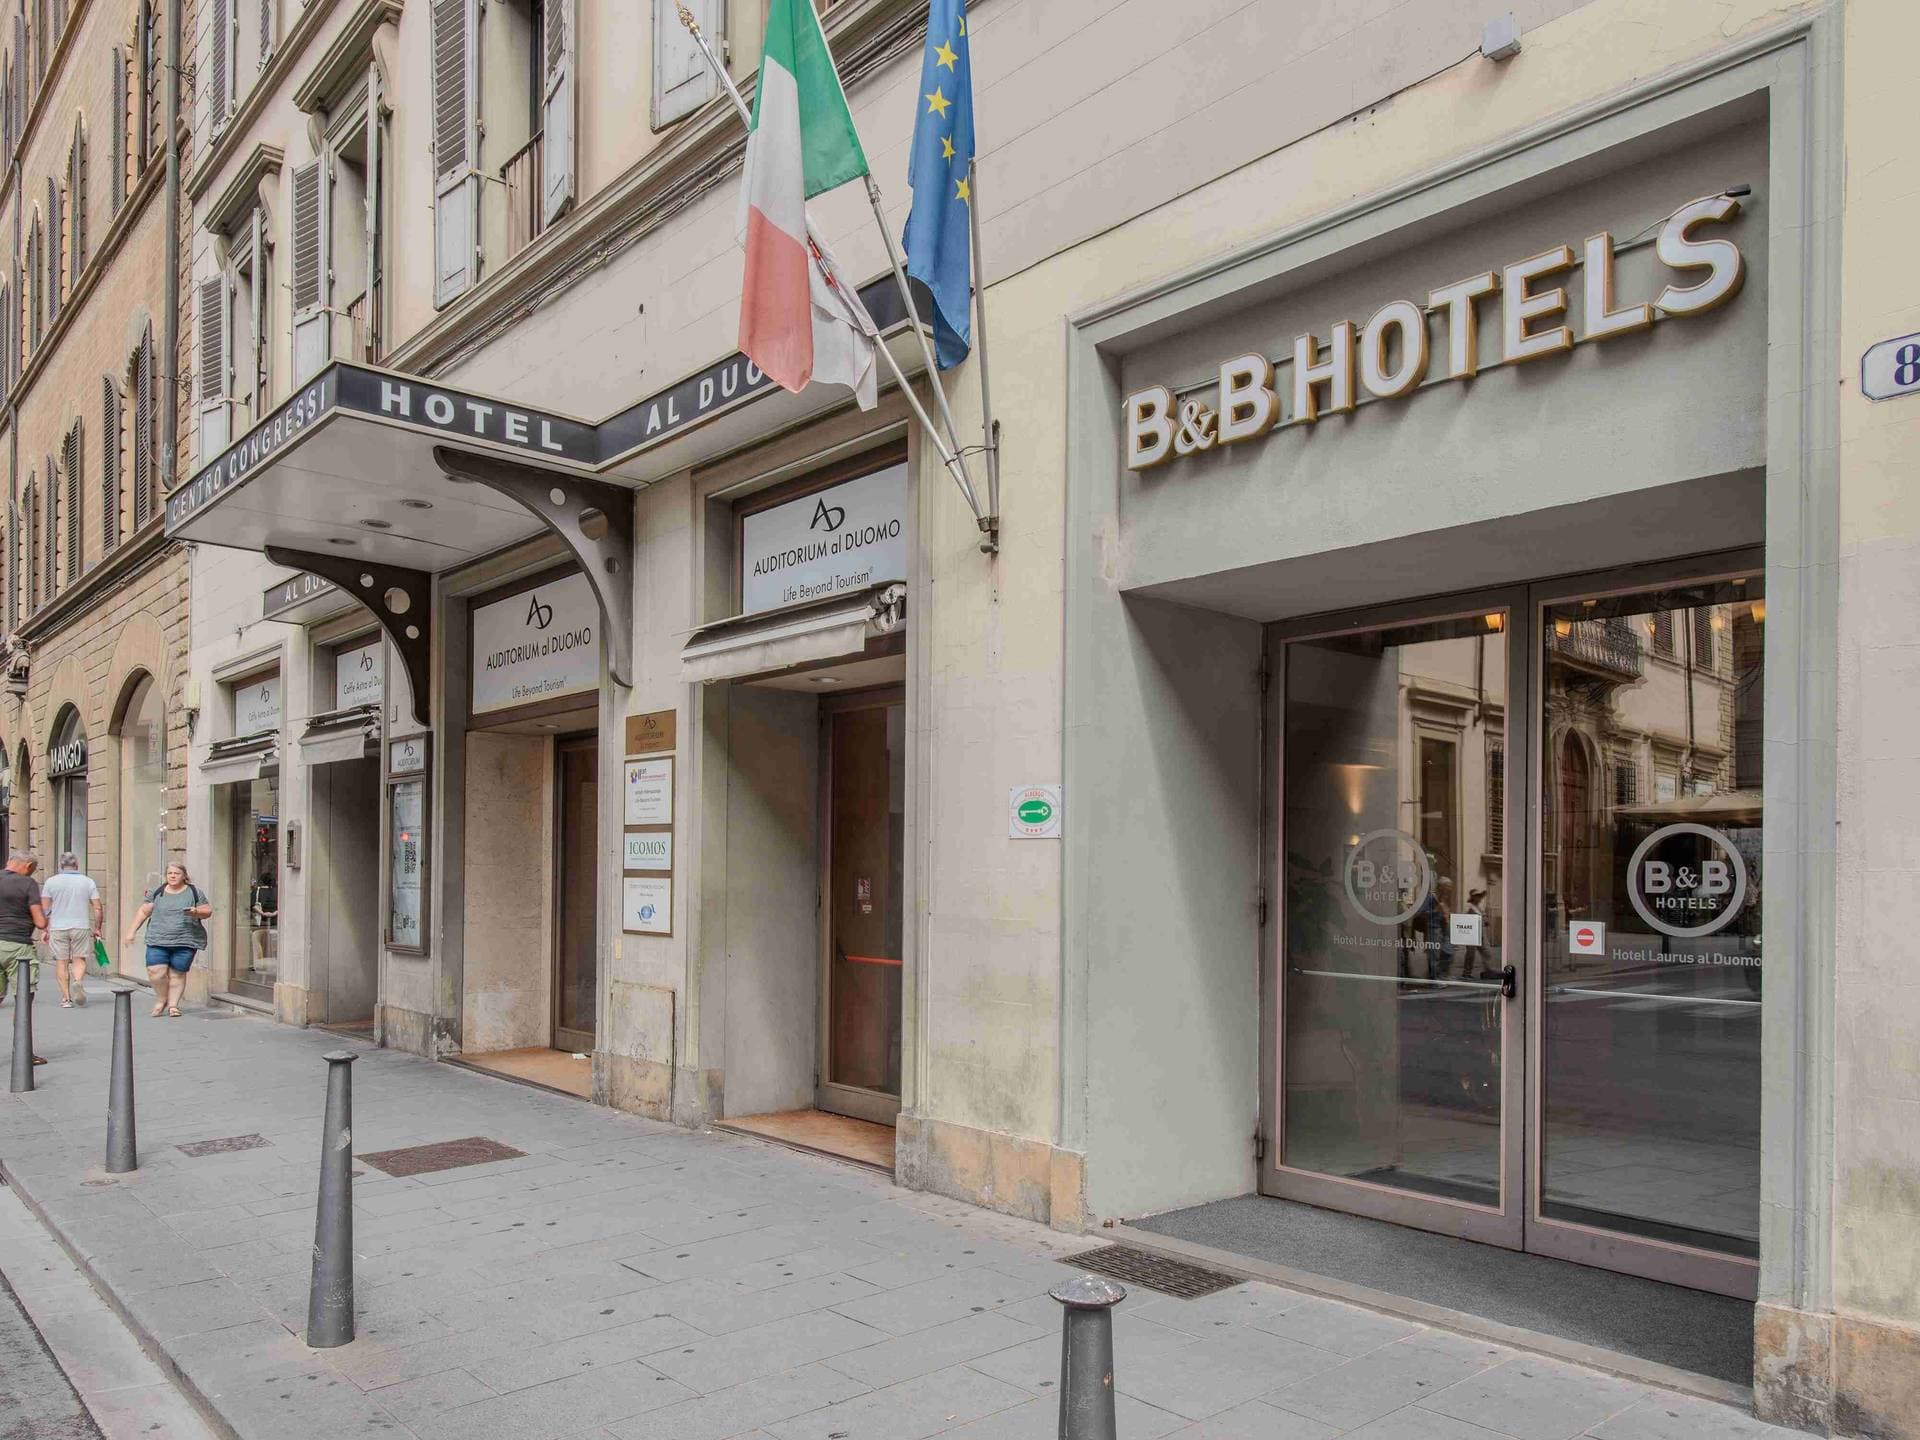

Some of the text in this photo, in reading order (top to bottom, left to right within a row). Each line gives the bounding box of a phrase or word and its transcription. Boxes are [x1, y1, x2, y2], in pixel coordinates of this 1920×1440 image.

[1127, 194, 1746, 471] B&B HOTELS
[381, 381, 562, 451] HOTEL
[646, 395, 680, 435] AL
[172, 382, 325, 521] CENTRO CONGRESSI
[753, 519, 900, 577] AUDITORIUM al DUOMO
[285, 582, 298, 602] AL
[783, 588, 797, 602] Life
[799, 576, 833, 598] Beyond
[486, 627, 591, 671] AUDITORIUM al DUOMO
[522, 681, 543, 697] Beyond
[50, 740, 81, 774] MANGO
[629, 840, 666, 855] ICOMOS
[1357, 860, 1418, 889] B&B
[1645, 860, 1731, 895] B&B
[1365, 891, 1410, 901] HOTELS
[1656, 897, 1717, 910] HOTELS
[1333, 934, 1441, 950] Hotel Laurus al Duomo
[1612, 949, 1761, 967] Hotel Laurus al Duomo
